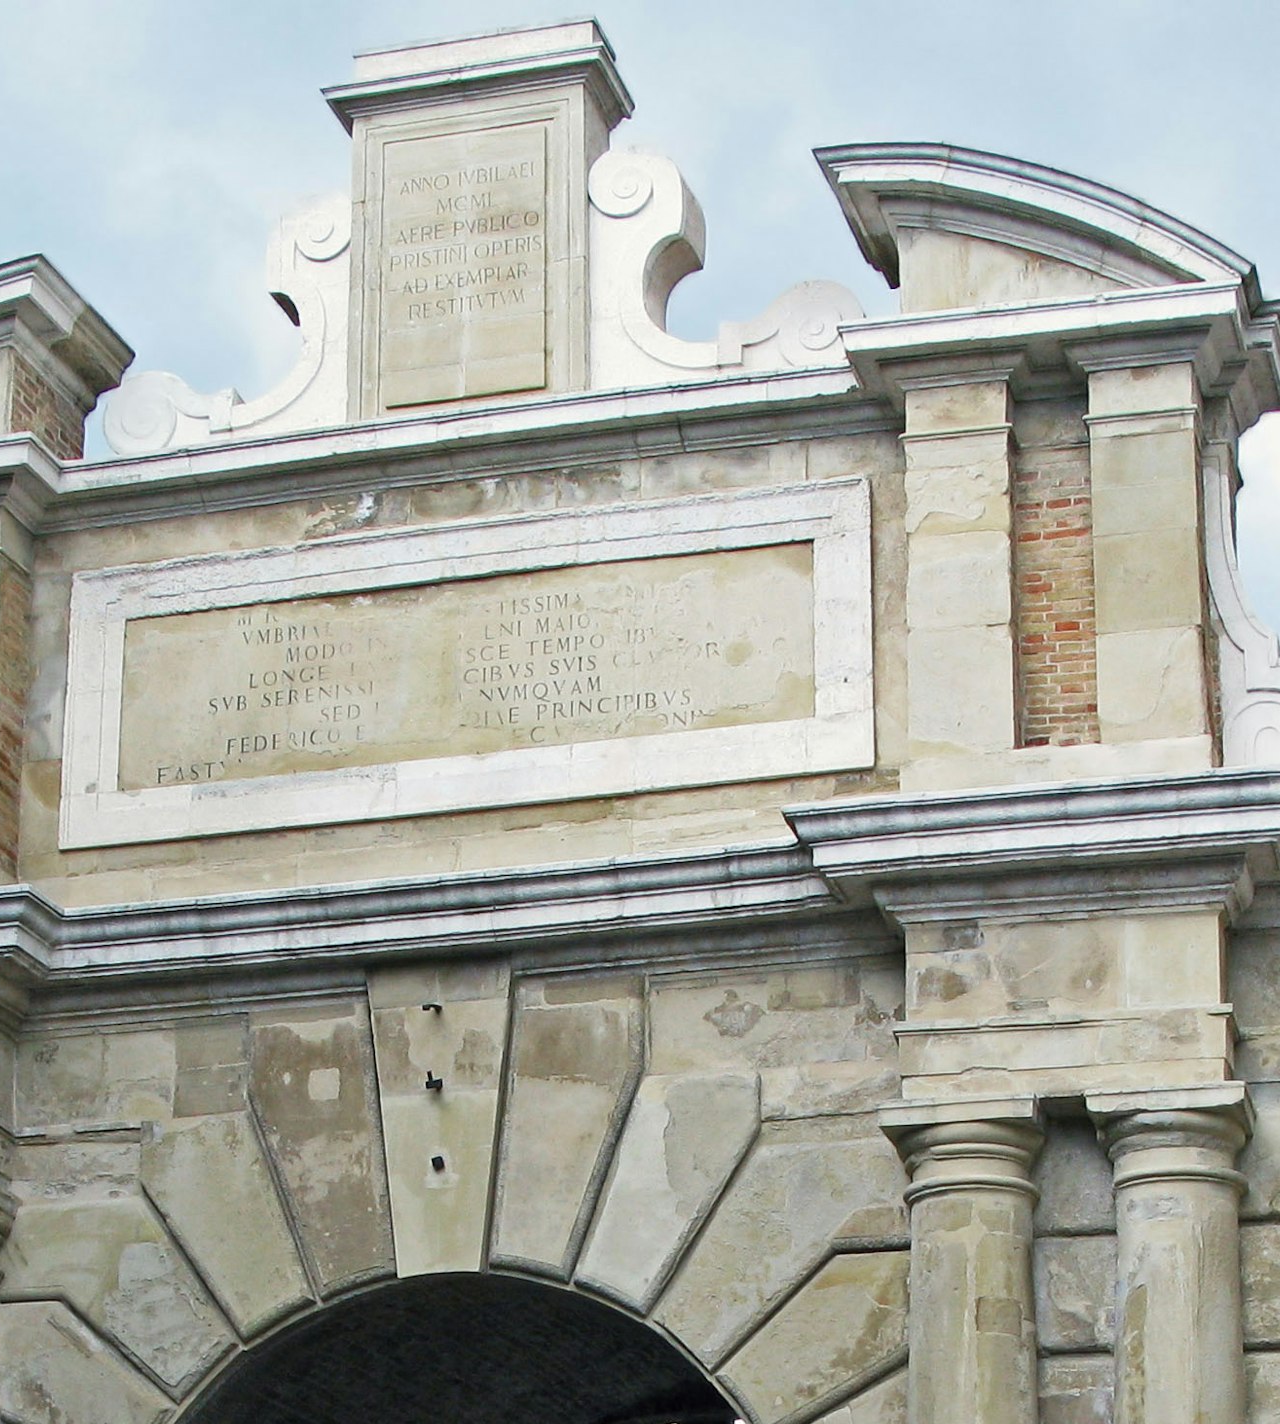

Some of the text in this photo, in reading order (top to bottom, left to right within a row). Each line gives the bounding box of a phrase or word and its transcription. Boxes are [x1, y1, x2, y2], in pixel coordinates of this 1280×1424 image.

[399, 173, 450, 196] ANNO
[436, 191, 497, 215] MCML
[453, 210, 540, 237] PVBLICO
[389, 235, 543, 272] PRISTINI OPERIS
[402, 277, 428, 296] AD
[208, 695, 248, 716] SVB
[463, 661, 535, 685] CIBVS
[548, 654, 597, 677] SVIS
[319, 703, 362, 724] SED
[535, 688, 692, 722] PRINCIPIBVS
